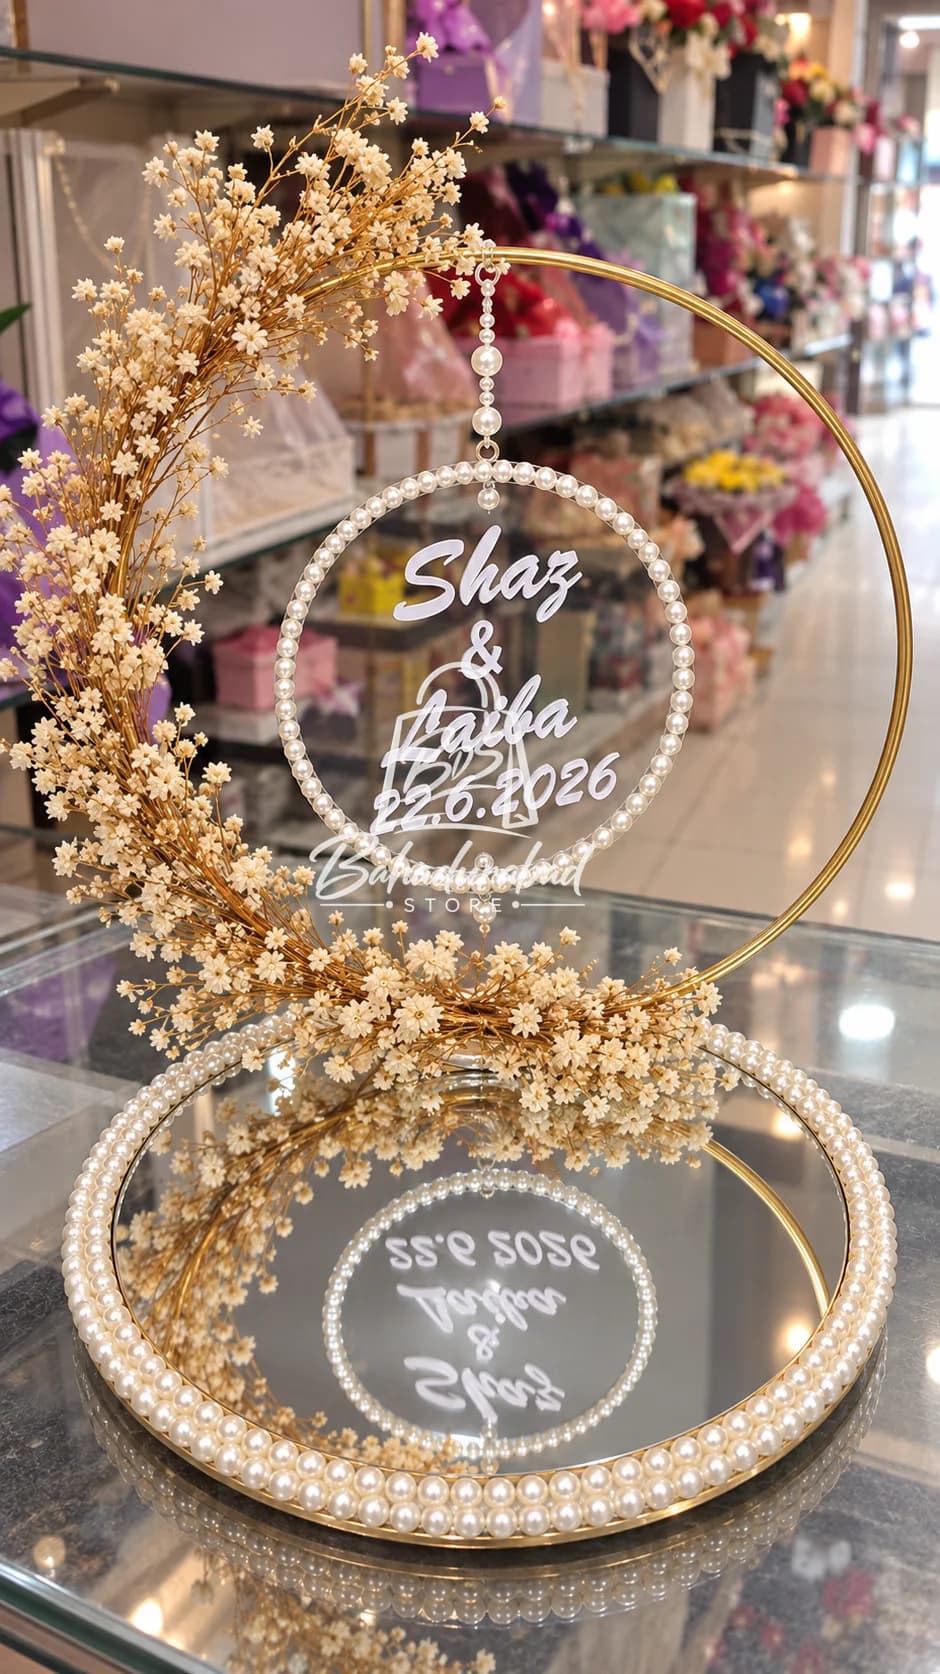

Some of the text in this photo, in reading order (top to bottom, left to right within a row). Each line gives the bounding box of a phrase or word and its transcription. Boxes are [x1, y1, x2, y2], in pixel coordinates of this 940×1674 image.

[393, 525, 583, 623] Shaz
[460, 619, 503, 680] &
[381, 674, 578, 768] Laiba
[370, 752, 622, 836] 22.6.2026
